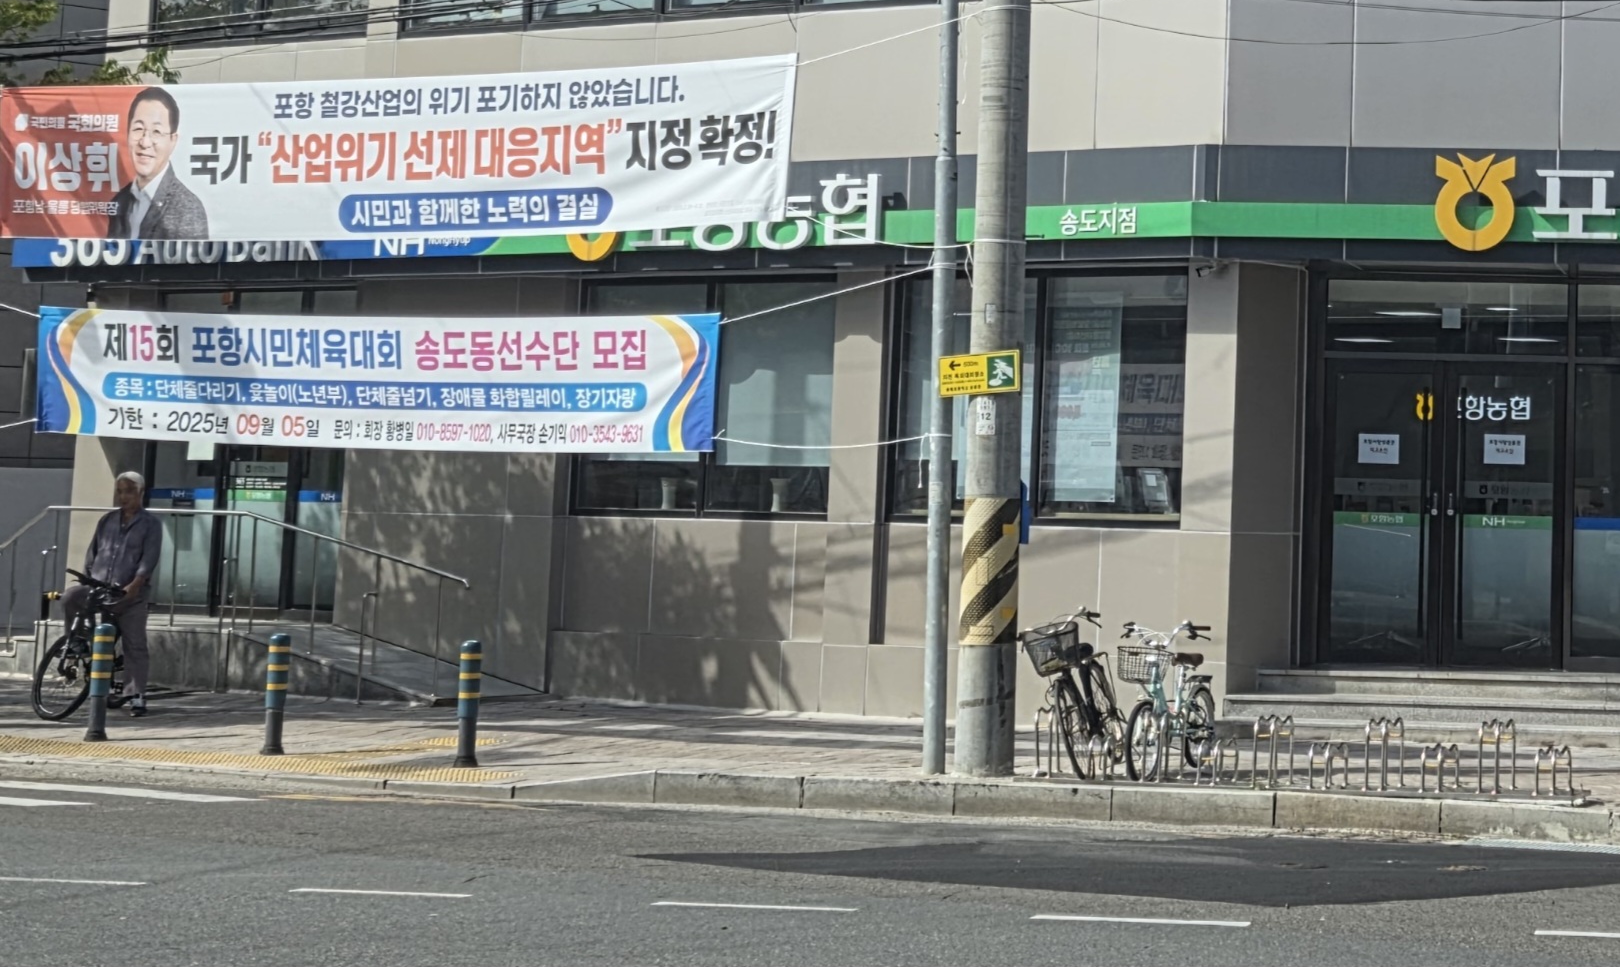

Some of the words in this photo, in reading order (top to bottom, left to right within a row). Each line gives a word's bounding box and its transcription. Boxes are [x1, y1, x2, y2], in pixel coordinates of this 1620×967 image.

[273, 92, 315, 119] 포항
[320, 89, 423, 118] 철강산업의
[429, 86, 471, 115] 위기
[476, 82, 562, 113] 포기하지
[569, 75, 686, 109] 않았습니다.
[68, 113, 120, 132] 국회의원
[190, 135, 253, 185] 국가
[403, 129, 468, 181] 선제
[625, 118, 692, 171] 지정
[697, 110, 778, 166] 확정!
[14, 142, 120, 192] 이상휘
[351, 199, 412, 226] 시민과
[417, 197, 480, 225] 함께한
[487, 195, 550, 223] 노력의
[556, 193, 599, 221] 결실
[630, 174, 879, 251] 농협
[1059, 206, 1137, 236] 송도지점
[374, 238, 425, 256] NH
[103, 323, 180, 363] 제15회
[191, 326, 402, 370] 포항시민체육대회
[415, 330, 579, 371] 송도동선수단
[593, 330, 647, 370] 모집
[114, 377, 144, 398] 종목
[155, 379, 246, 402] 단체줄다리기,
[357, 386, 437, 407] 단체줄넘기,
[440, 386, 487, 407] 장애물
[490, 387, 571, 409] 화합릴레이,
[575, 388, 637, 409] 장기자랑
[1457, 395, 1532, 421] 항농협
[107, 406, 143, 430] 기한
[166, 410, 229, 434] 2025년
[236, 413, 275, 436] 09월
[281, 414, 319, 438] 05일
[334, 419, 354, 439] 문의
[364, 420, 383, 440] 회장
[497, 423, 536, 444] 사무국장
[320, 493, 336, 501] NH
[1482, 516, 1505, 526] NH
